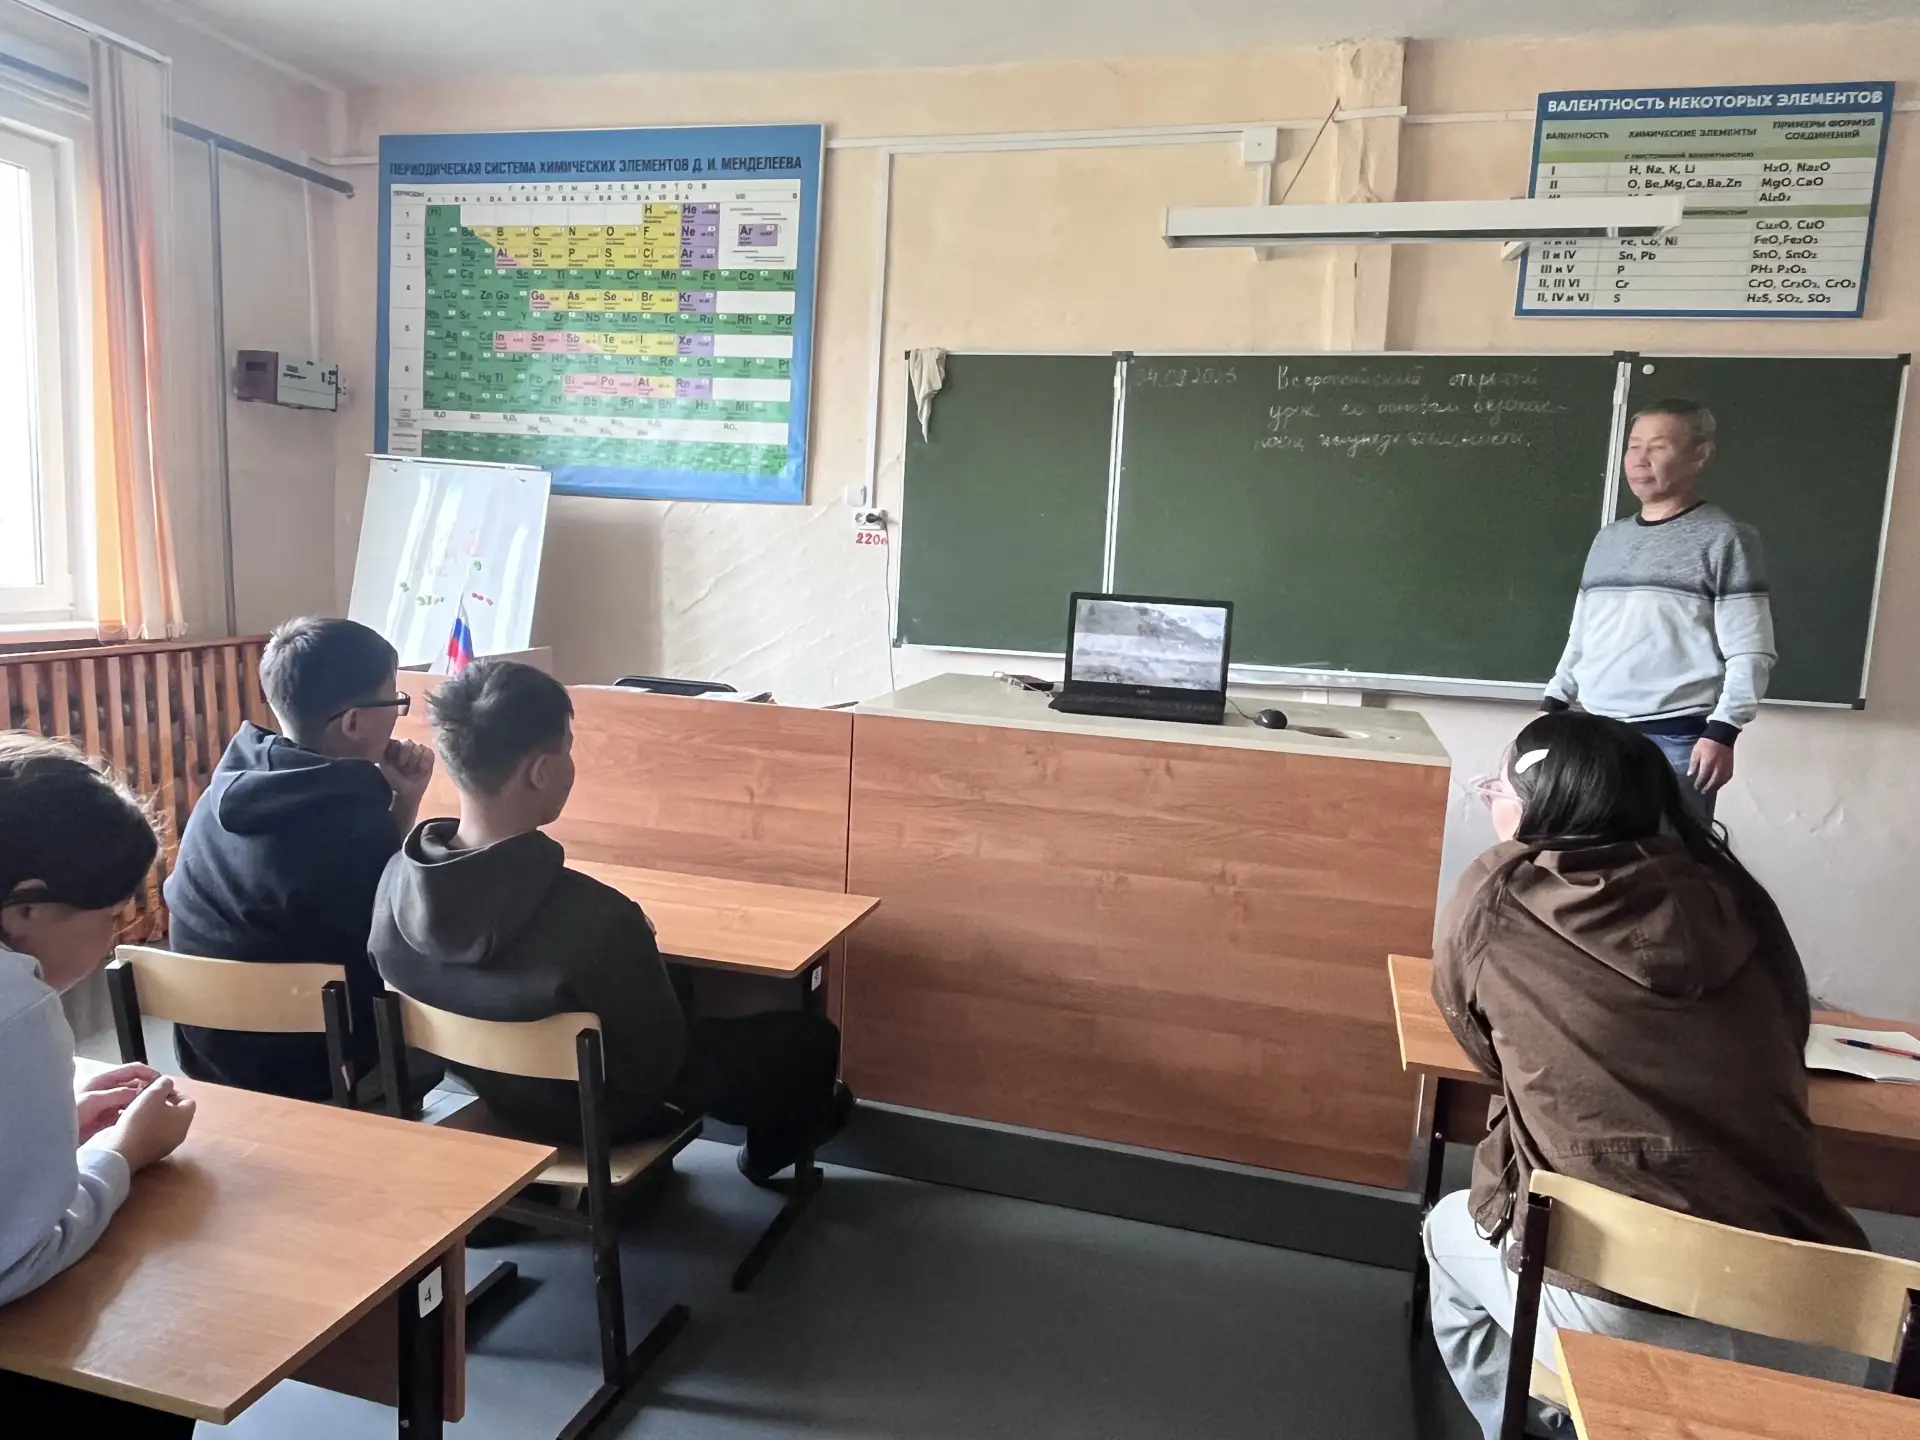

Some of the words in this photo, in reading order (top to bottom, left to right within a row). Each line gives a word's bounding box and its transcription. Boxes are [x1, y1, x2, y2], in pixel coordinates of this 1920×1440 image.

[1548, 98, 1665, 112] ВАЛЕНТНОСТЬ
[1668, 94, 1772, 109] НЕКОТОРЫХ
[1776, 91, 1883, 106] ЭЛЕМЕНТОВ
[1546, 132, 1609, 140] ВАЛЕНТНОСТЬ
[1628, 129, 1697, 139] ХИМИЧЕСКИЕ
[390, 161, 482, 176] ПЕРИОДИЧЕСКАЯ
[484, 161, 536, 175] СИСТЕМА
[540, 159, 616, 174] ХИМИЧЕСКИХ
[619, 158, 689, 172] ЭЛЕМЕНТОВ
[707, 157, 718, 171] И.
[722, 156, 802, 171] МЕНДЕЛЕЕВА
[1797, 220, 1825, 229] CuO
[497, 227, 504, 237] B
[533, 227, 540, 236] C
[569, 227, 576, 236] N
[606, 227, 614, 236] O
[644, 227, 650, 236] F
[682, 227, 695, 236] Ne
[740, 226, 752, 235] Ar
[497, 248, 507, 257] Al
[533, 248, 542, 257] Si
[569, 248, 575, 257] P
[605, 248, 612, 258] S
[644, 248, 654, 258] Cl
[681, 248, 693, 258] Ar
[1641, 251, 1656, 260] Pb
[1617, 266, 1625, 274] P
[627, 270, 639, 280] Cr
[661, 270, 676, 280] Mn
[702, 271, 715, 281] Fe
[739, 271, 754, 281] Co
[783, 271, 794, 281] Ni
[1615, 280, 1630, 289] Cr
